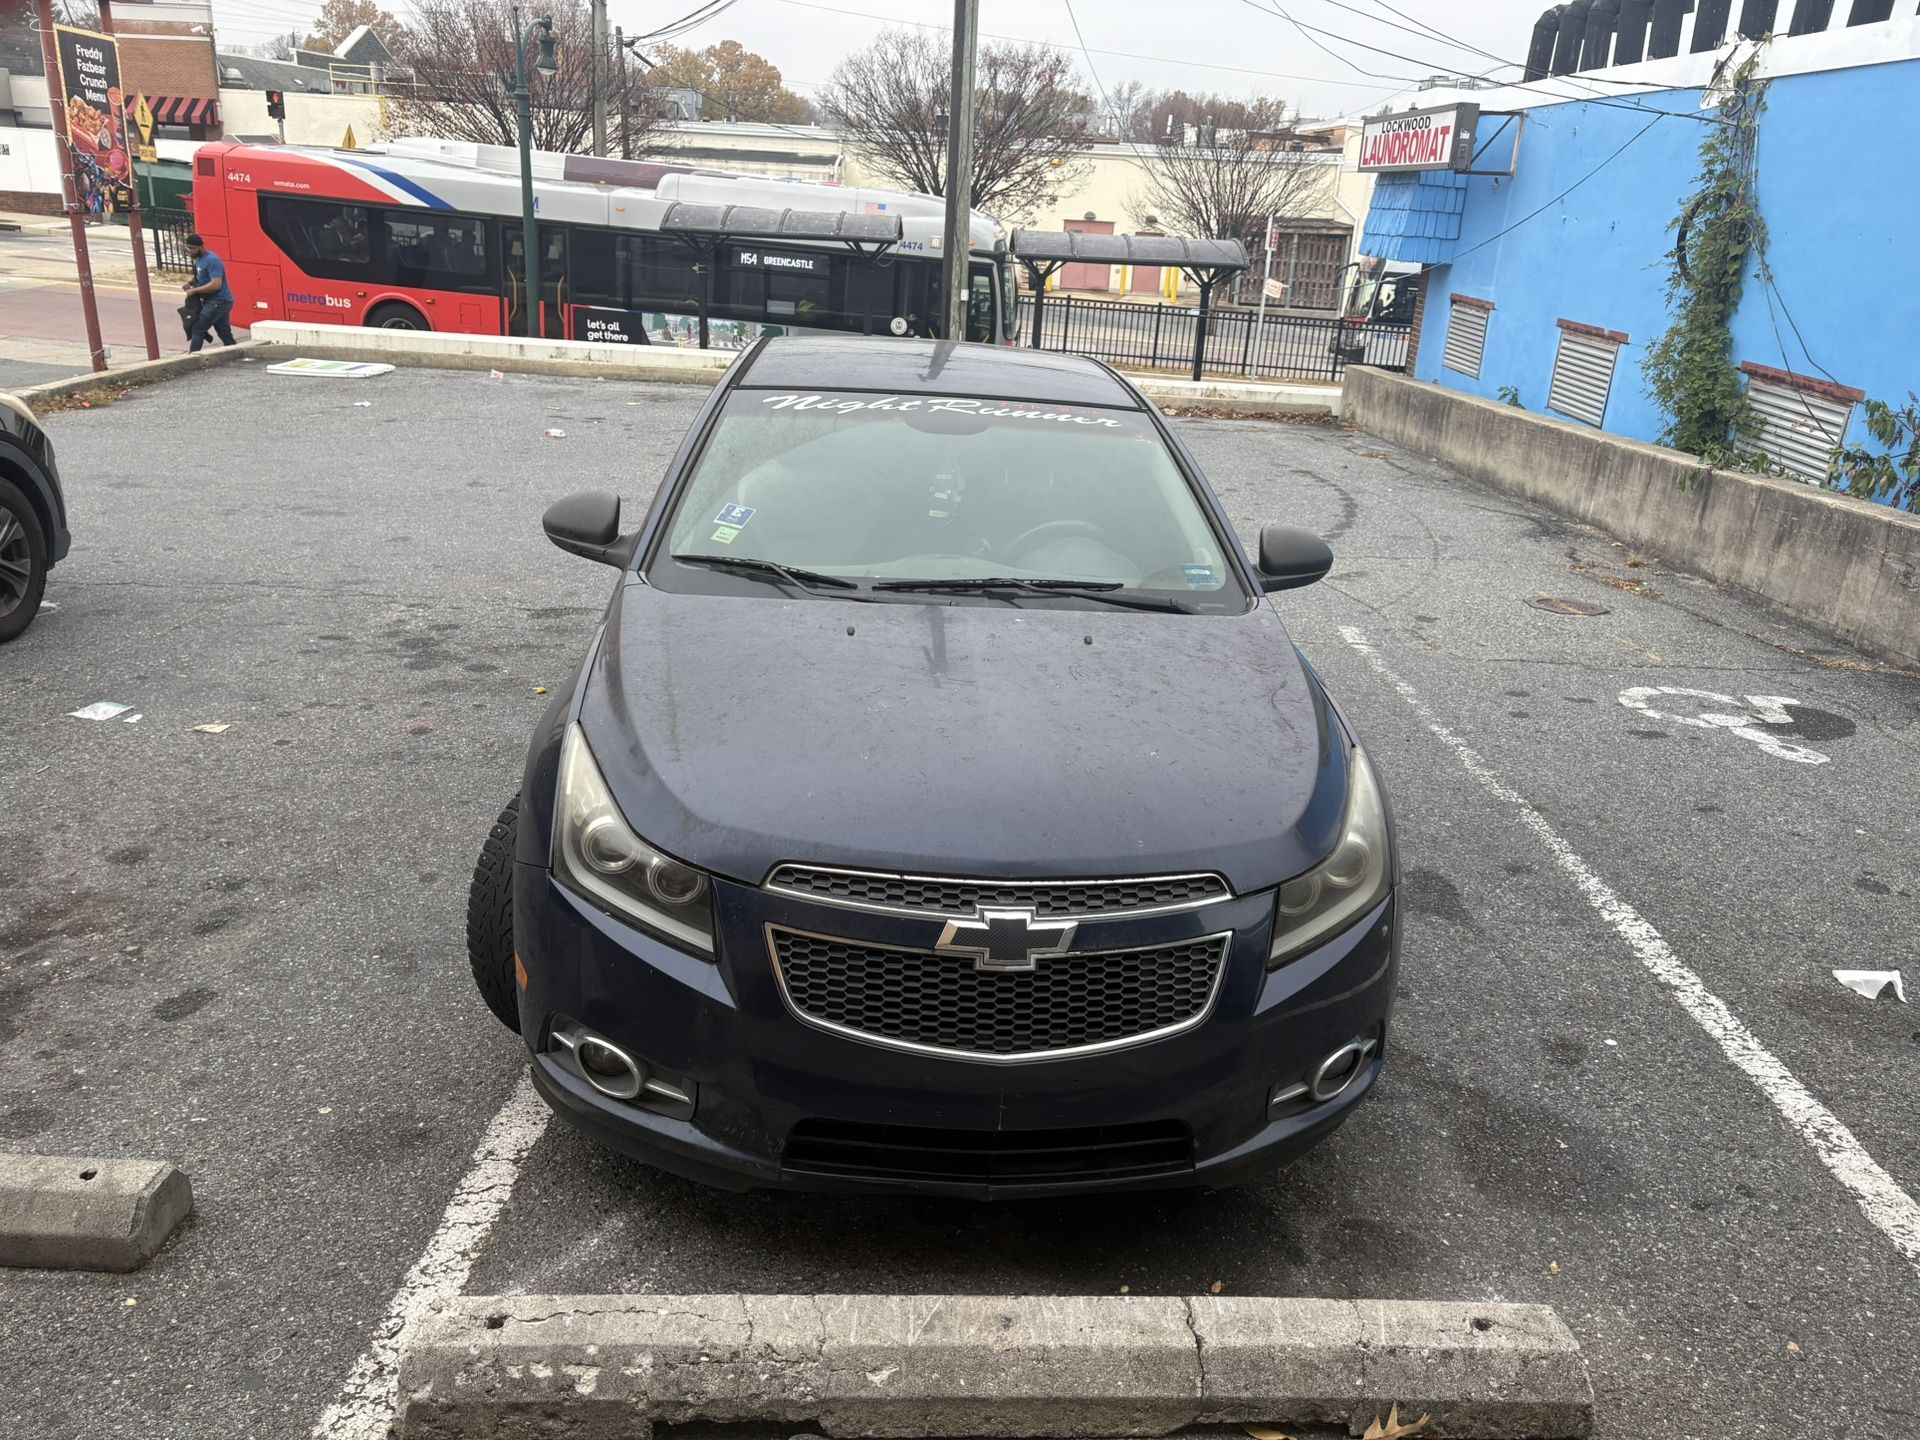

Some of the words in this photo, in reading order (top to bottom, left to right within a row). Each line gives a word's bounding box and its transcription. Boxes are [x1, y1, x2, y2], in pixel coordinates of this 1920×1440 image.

[75, 44, 103, 62] Freddy
[76, 58, 106, 75] Fazbear
[80, 73, 108, 89] Crunch
[85, 88, 107, 103] Menu
[1381, 116, 1431, 134] LOCKWOOD
[1362, 125, 1451, 166] LAUNDROMAT
[228, 172, 251, 183] 4474
[273, 180, 310, 190] wmata.com
[900, 241, 923, 251] 4474
[741, 252, 757, 265] M54
[763, 256, 814, 269] GREENCASTLE
[287, 293, 352, 309] metrobus
[587, 319, 606, 330] let's
[607, 322, 620, 331] all
[587, 331, 603, 341] get
[604, 331, 629, 342] there
[762, 395, 923, 415] Night
[928, 399, 1123, 427] Runner
